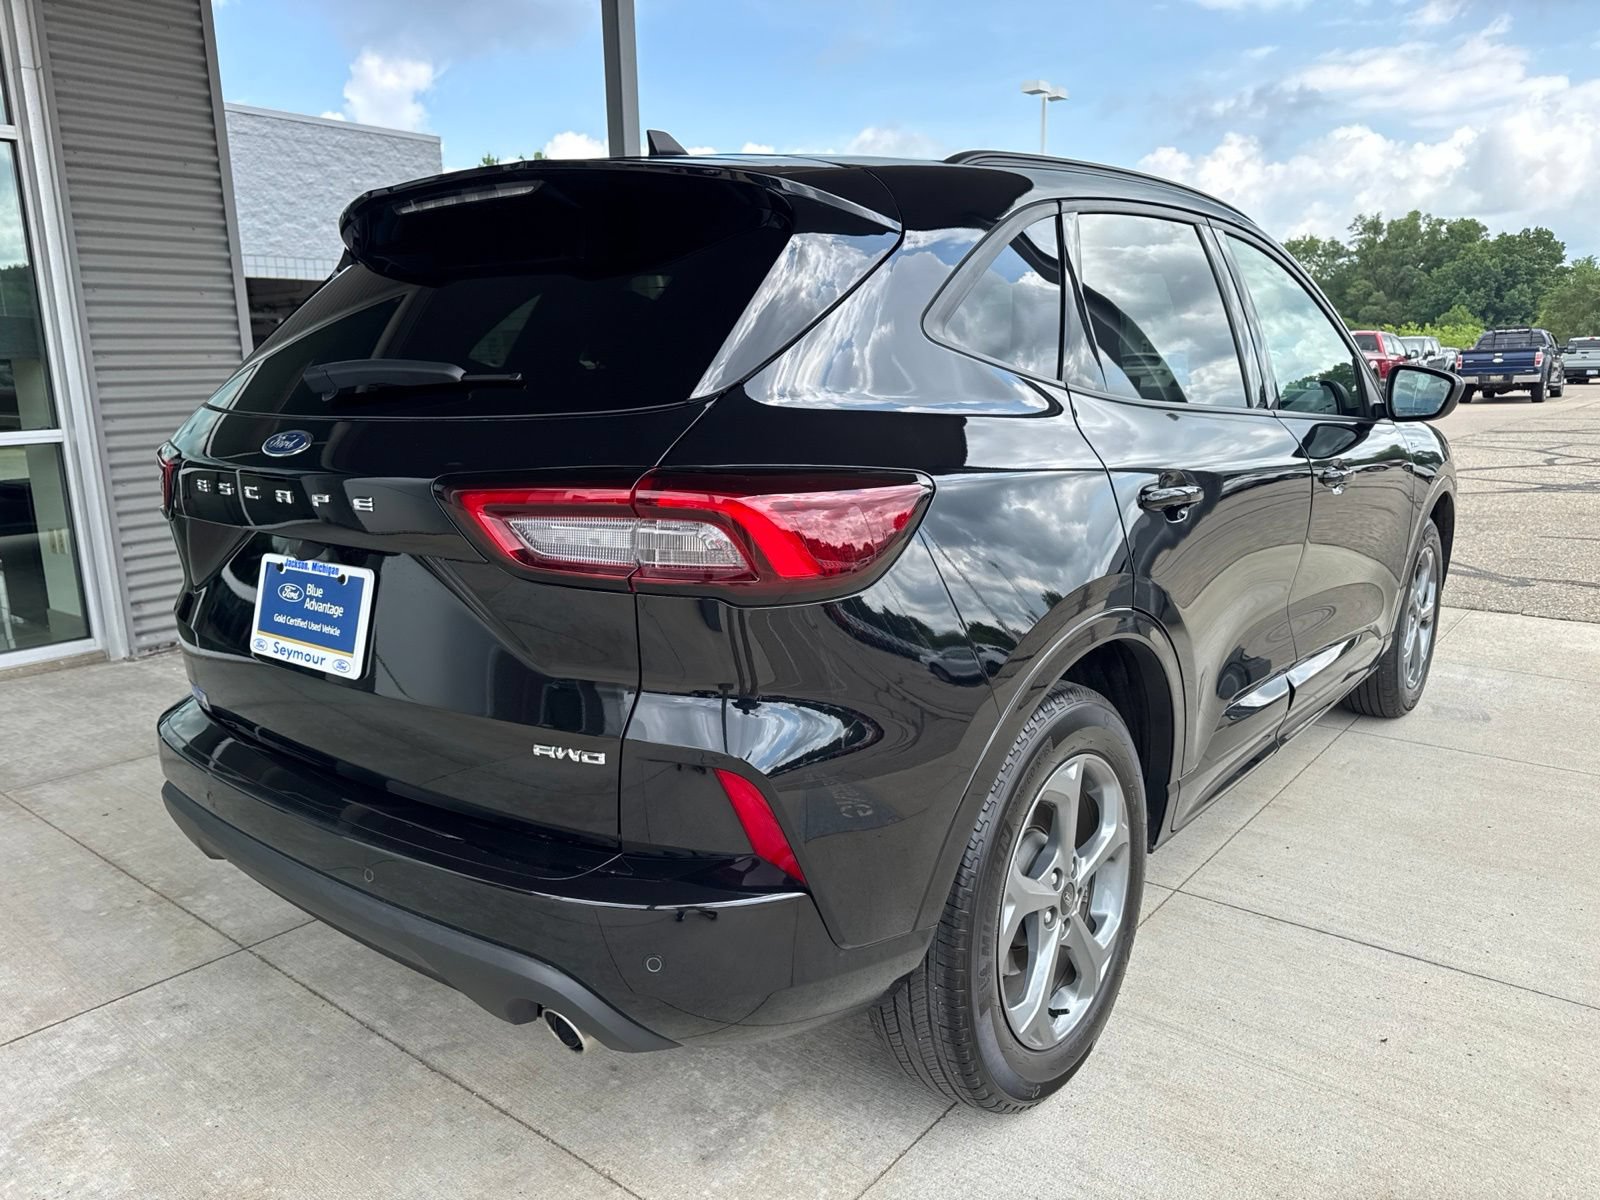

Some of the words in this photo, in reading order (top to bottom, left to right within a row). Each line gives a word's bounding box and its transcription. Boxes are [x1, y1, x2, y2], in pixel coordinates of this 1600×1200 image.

[269, 434, 301, 450] Ford
[196, 478, 375, 512] ESCAPE
[312, 562, 340, 576] Michigan
[282, 585, 300, 600] Ford
[306, 583, 324, 598] Blue
[304, 598, 344, 618] Advantage
[273, 613, 286, 623] Gold
[286, 616, 308, 629] Certified
[308, 621, 321, 633] Used
[321, 625, 341, 637] Vehicle
[273, 641, 326, 665] Seymour
[533, 744, 605, 765] AWD
